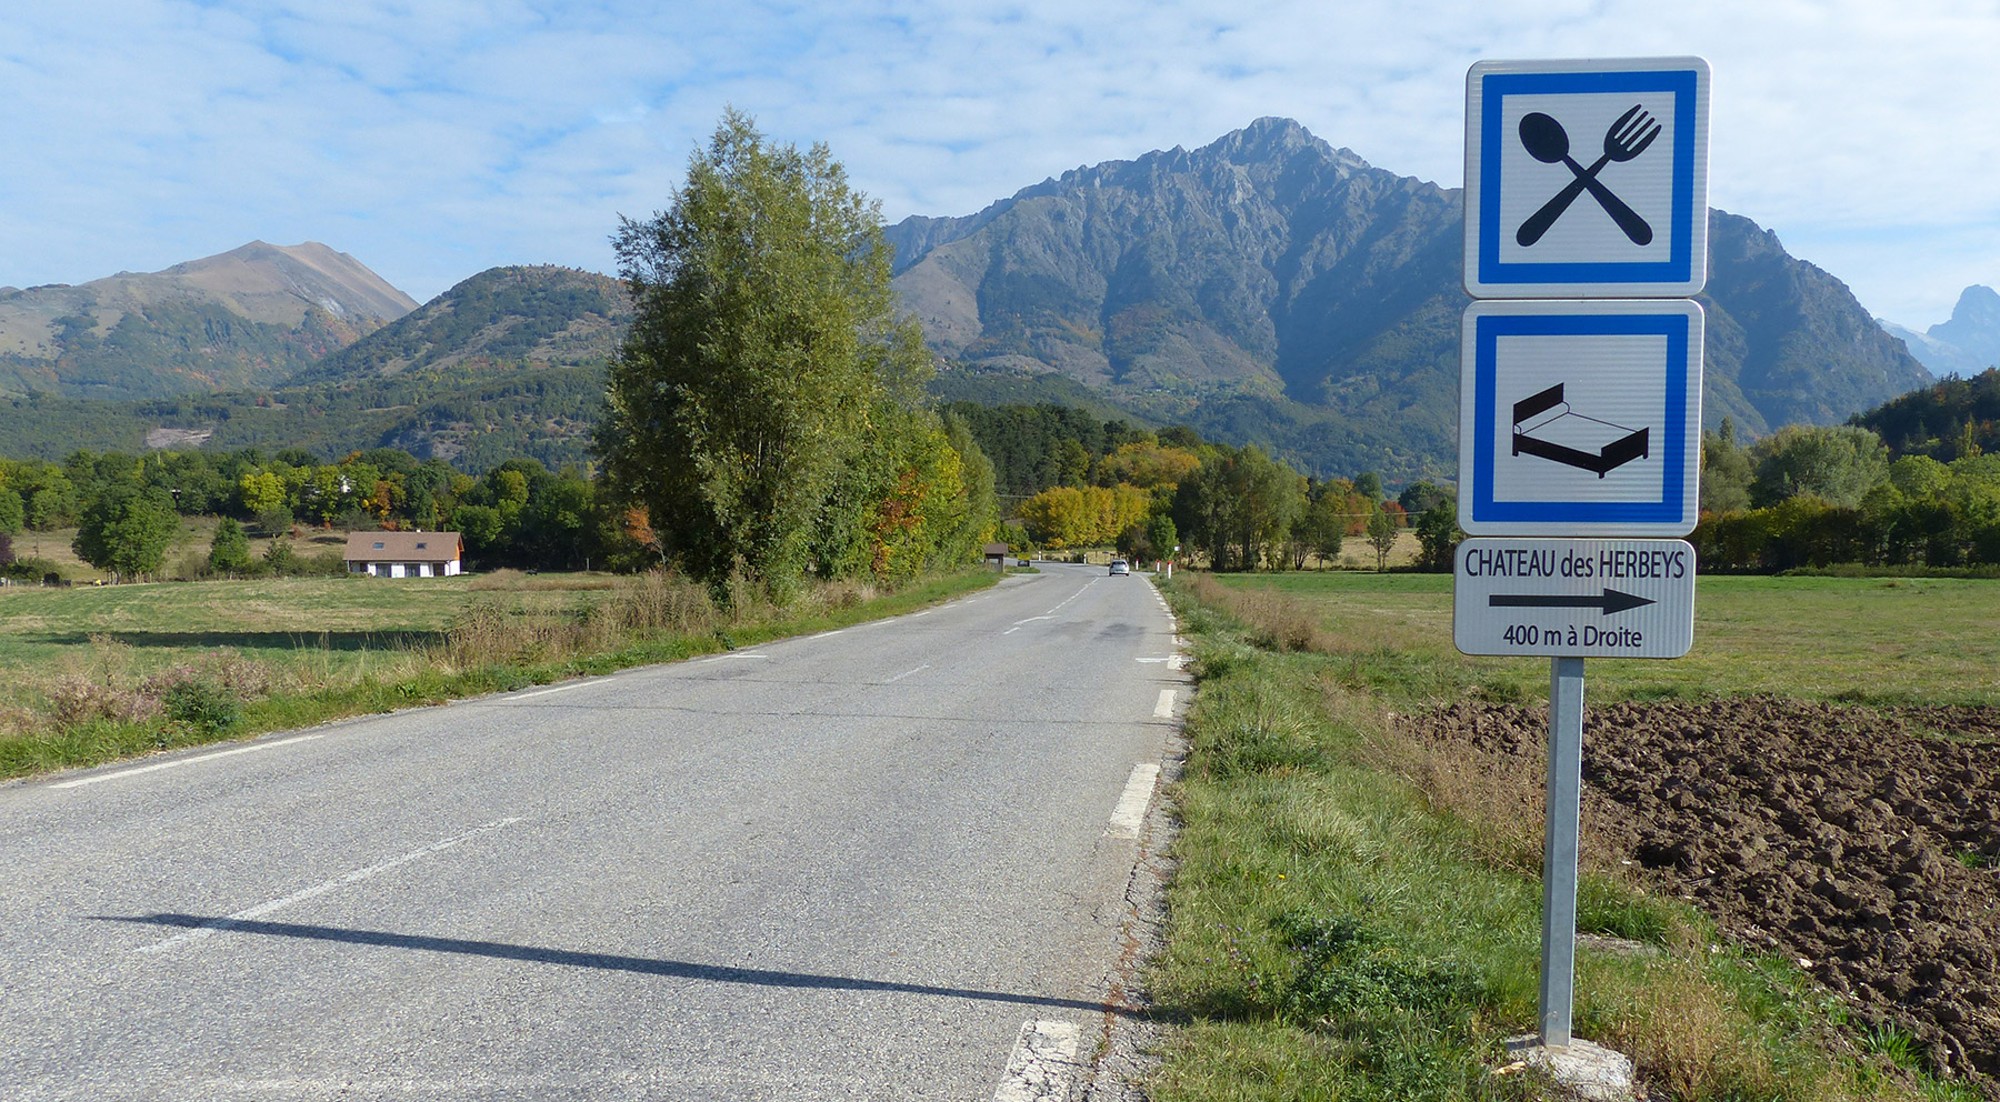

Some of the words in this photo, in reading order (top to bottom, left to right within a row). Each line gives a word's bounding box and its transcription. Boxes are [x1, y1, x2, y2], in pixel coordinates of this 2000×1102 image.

[1465, 548, 1556, 578] CHATEAU
[1560, 548, 1594, 578] des
[1599, 550, 1685, 579] HERBEYS
[1503, 624, 1539, 646] 400
[1544, 630, 1562, 647] m
[1567, 625, 1578, 647] à
[1583, 626, 1643, 648] Droite
